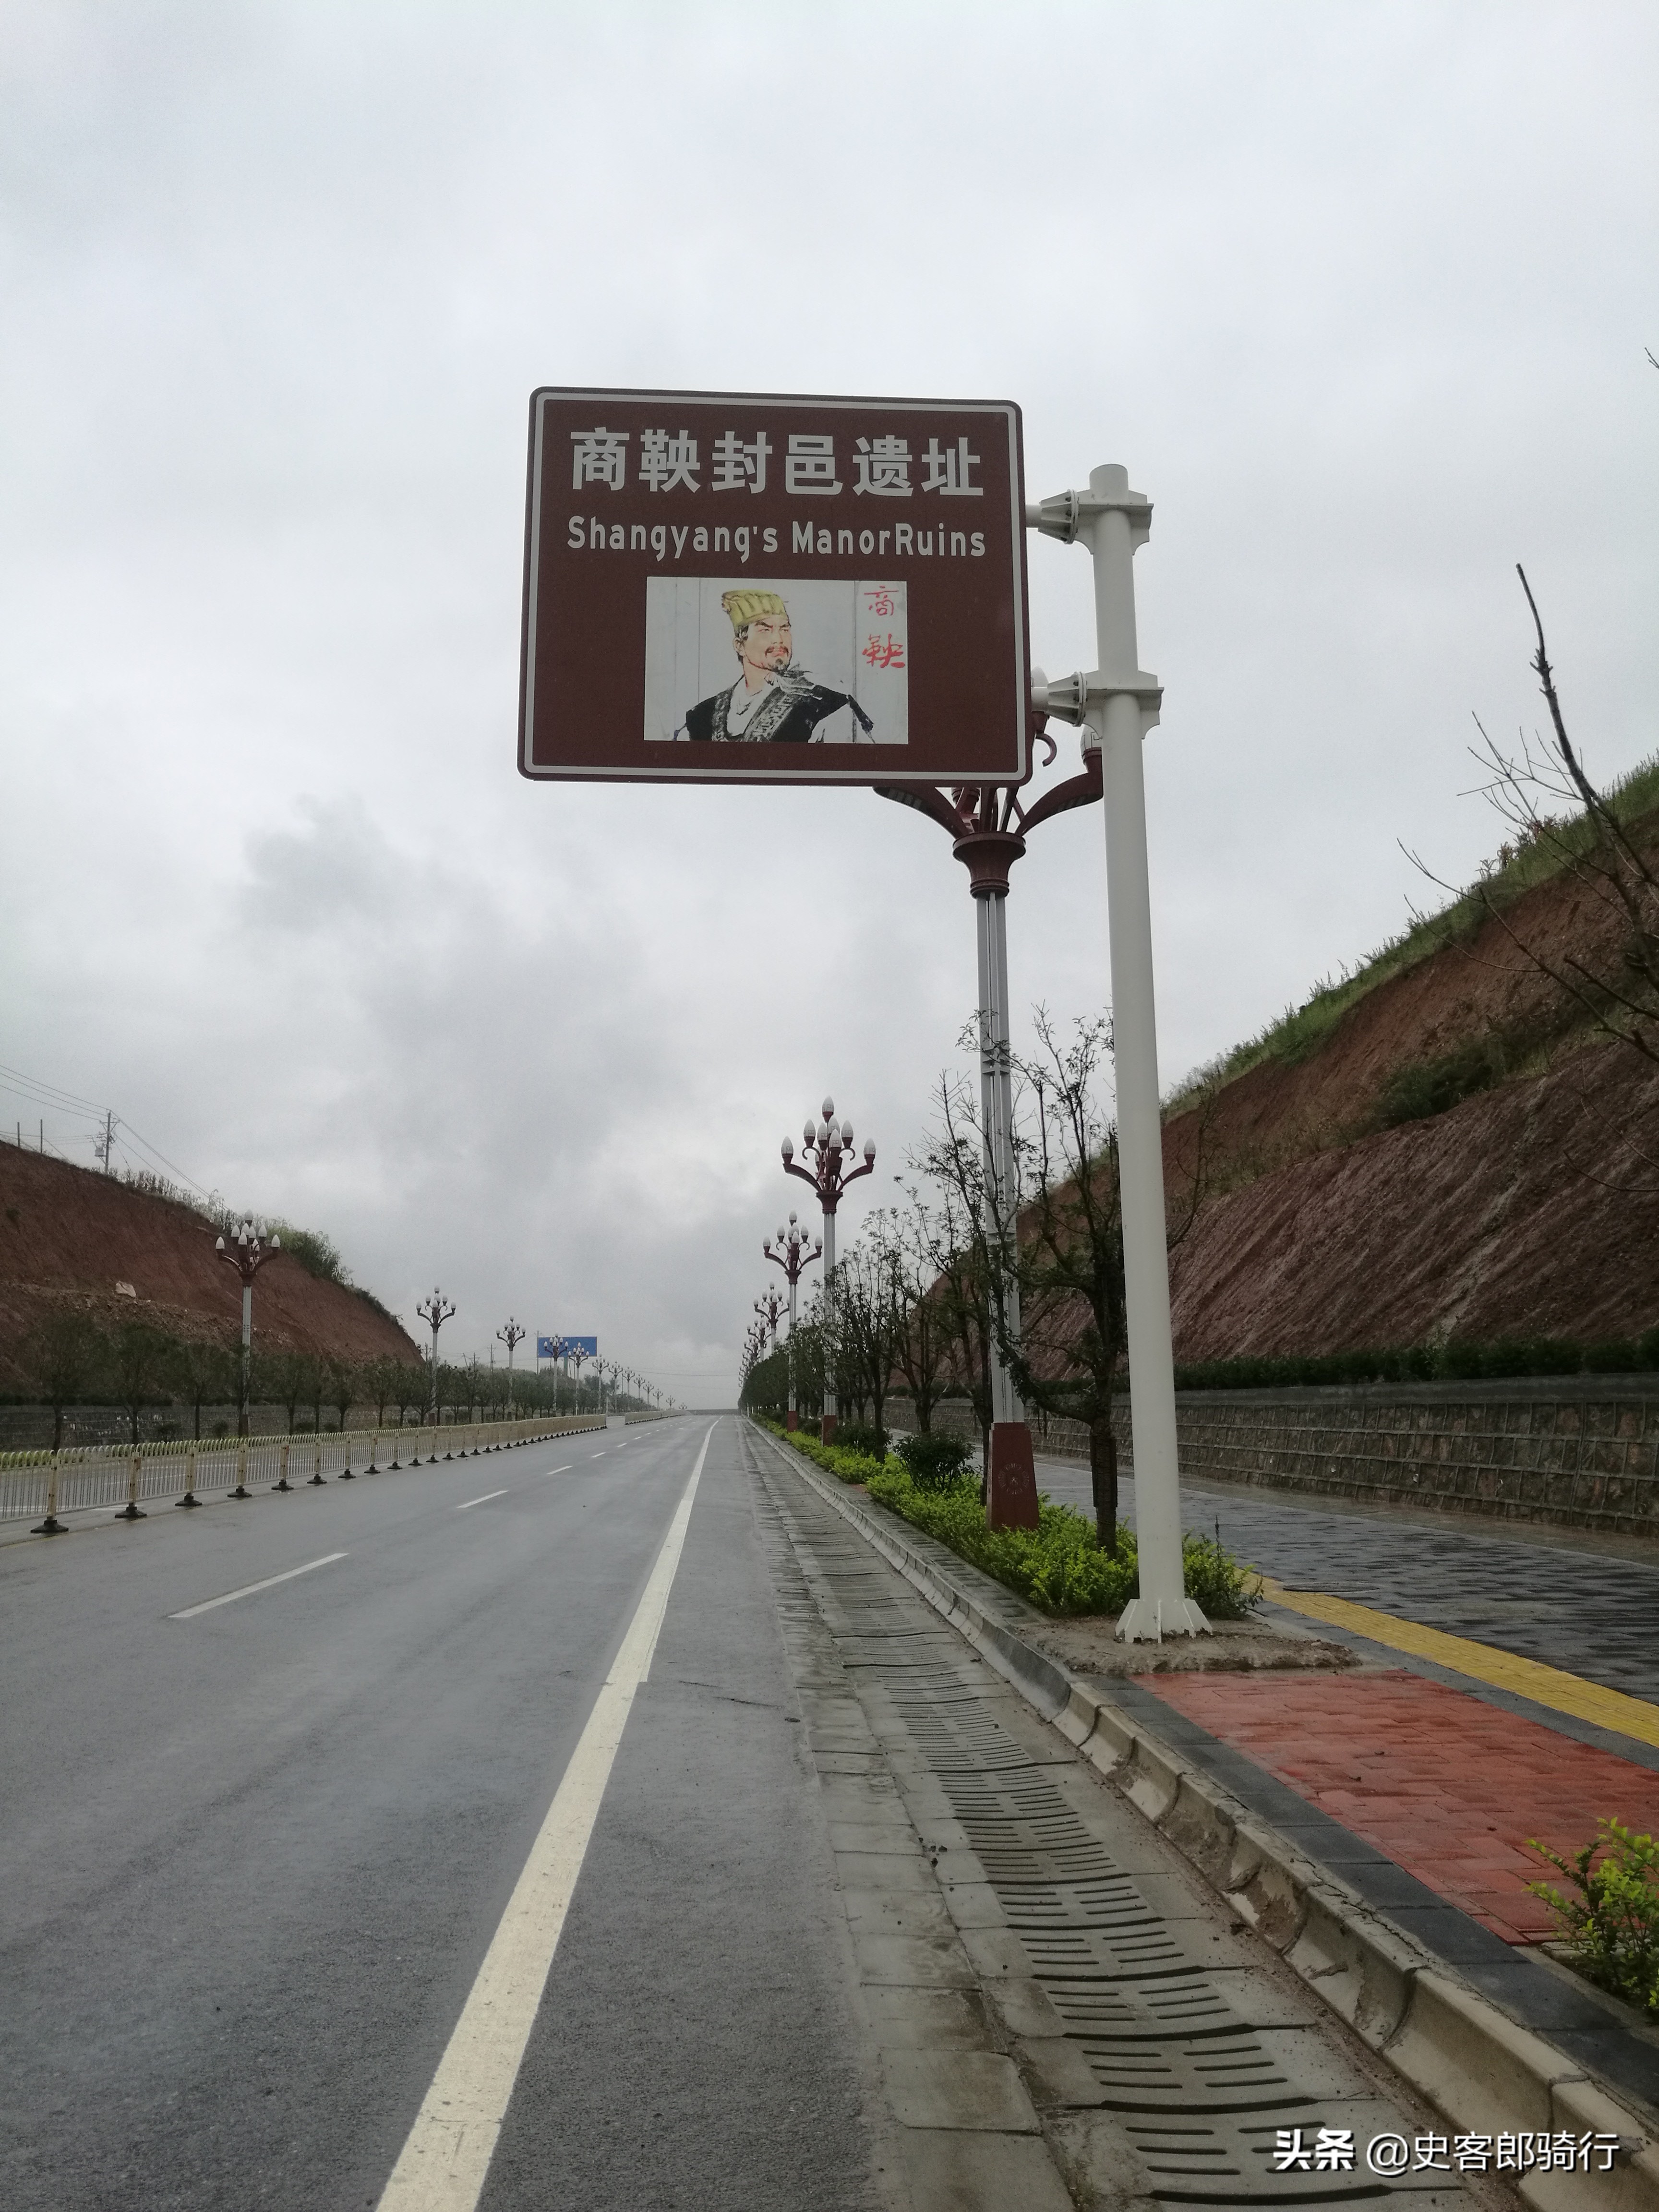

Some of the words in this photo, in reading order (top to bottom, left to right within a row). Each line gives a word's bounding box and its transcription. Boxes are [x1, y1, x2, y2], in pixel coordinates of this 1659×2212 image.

[570, 426, 984, 497] 商鞅封邑遗址
[567, 516, 778, 563] Shangyang's
